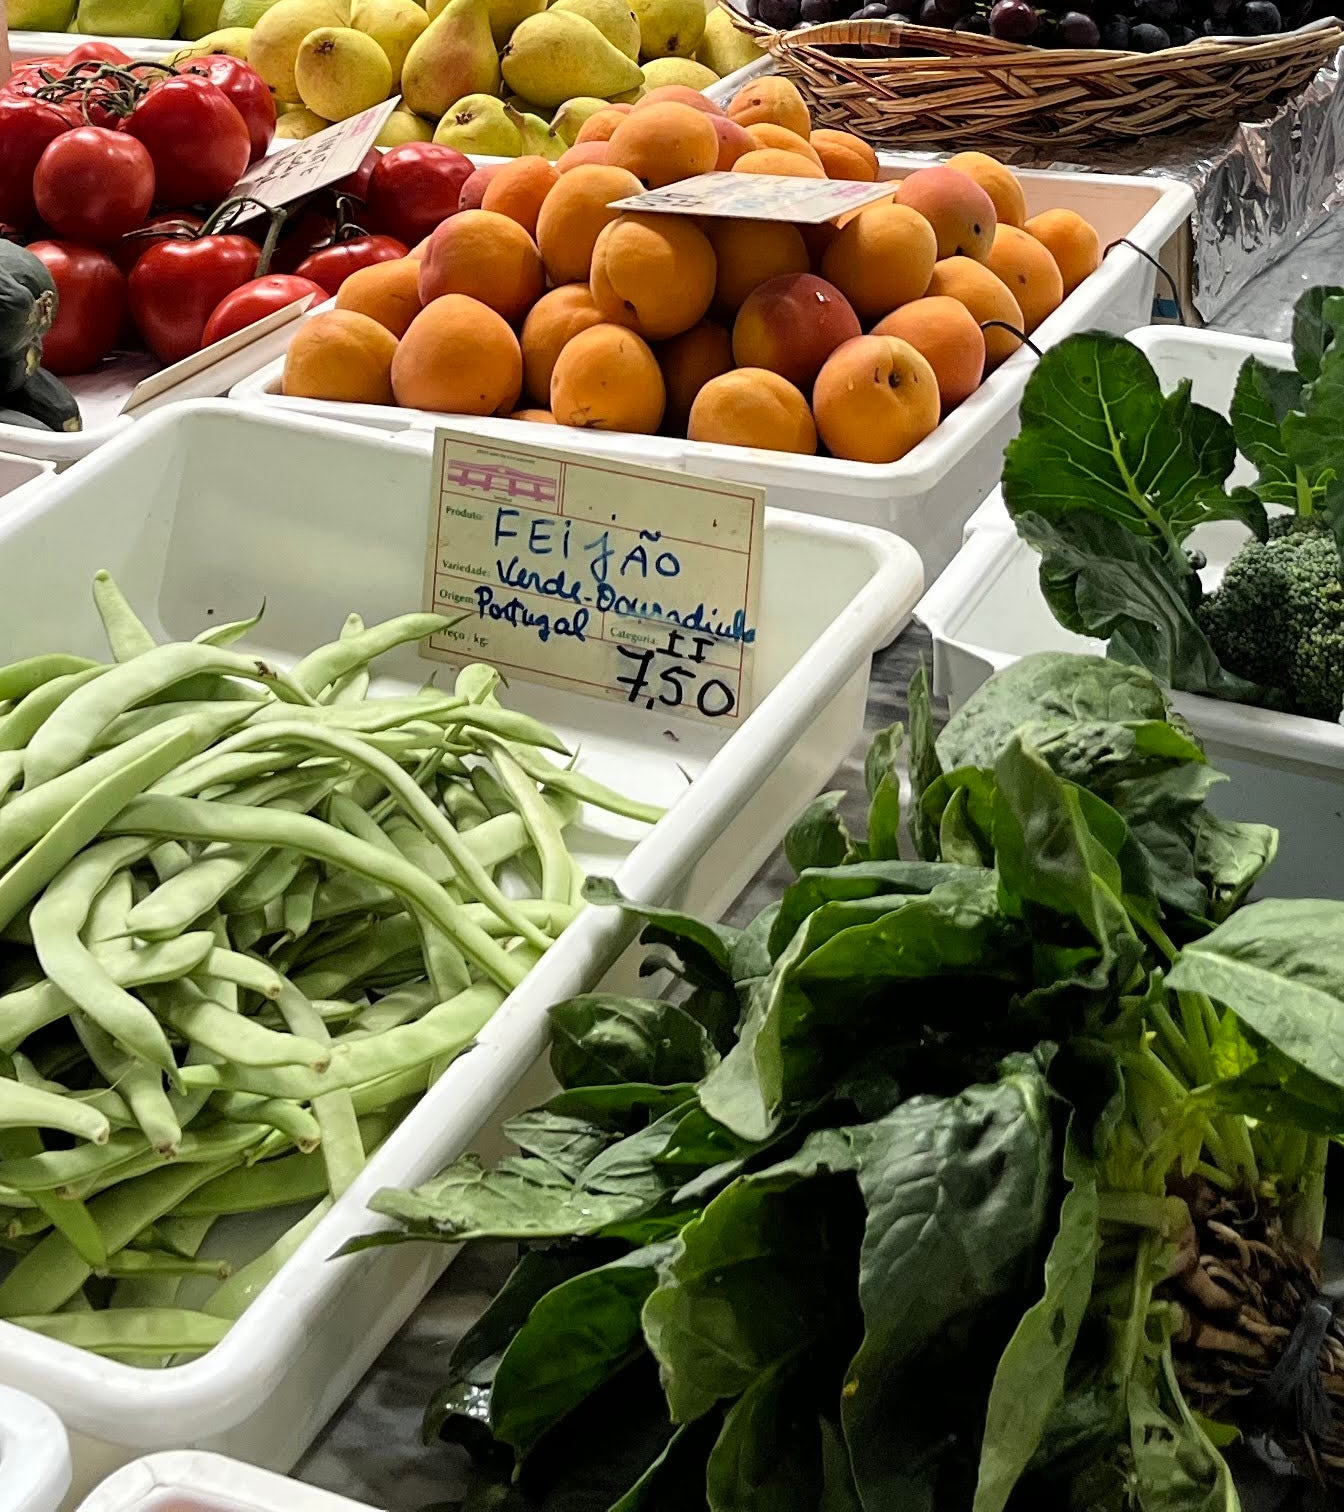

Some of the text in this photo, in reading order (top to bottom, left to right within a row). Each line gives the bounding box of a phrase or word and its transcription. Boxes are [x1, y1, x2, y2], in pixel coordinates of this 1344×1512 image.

[474, 585, 589, 643] Portugal
[656, 629, 715, 664] II
[616, 644, 736, 717] 7,50
